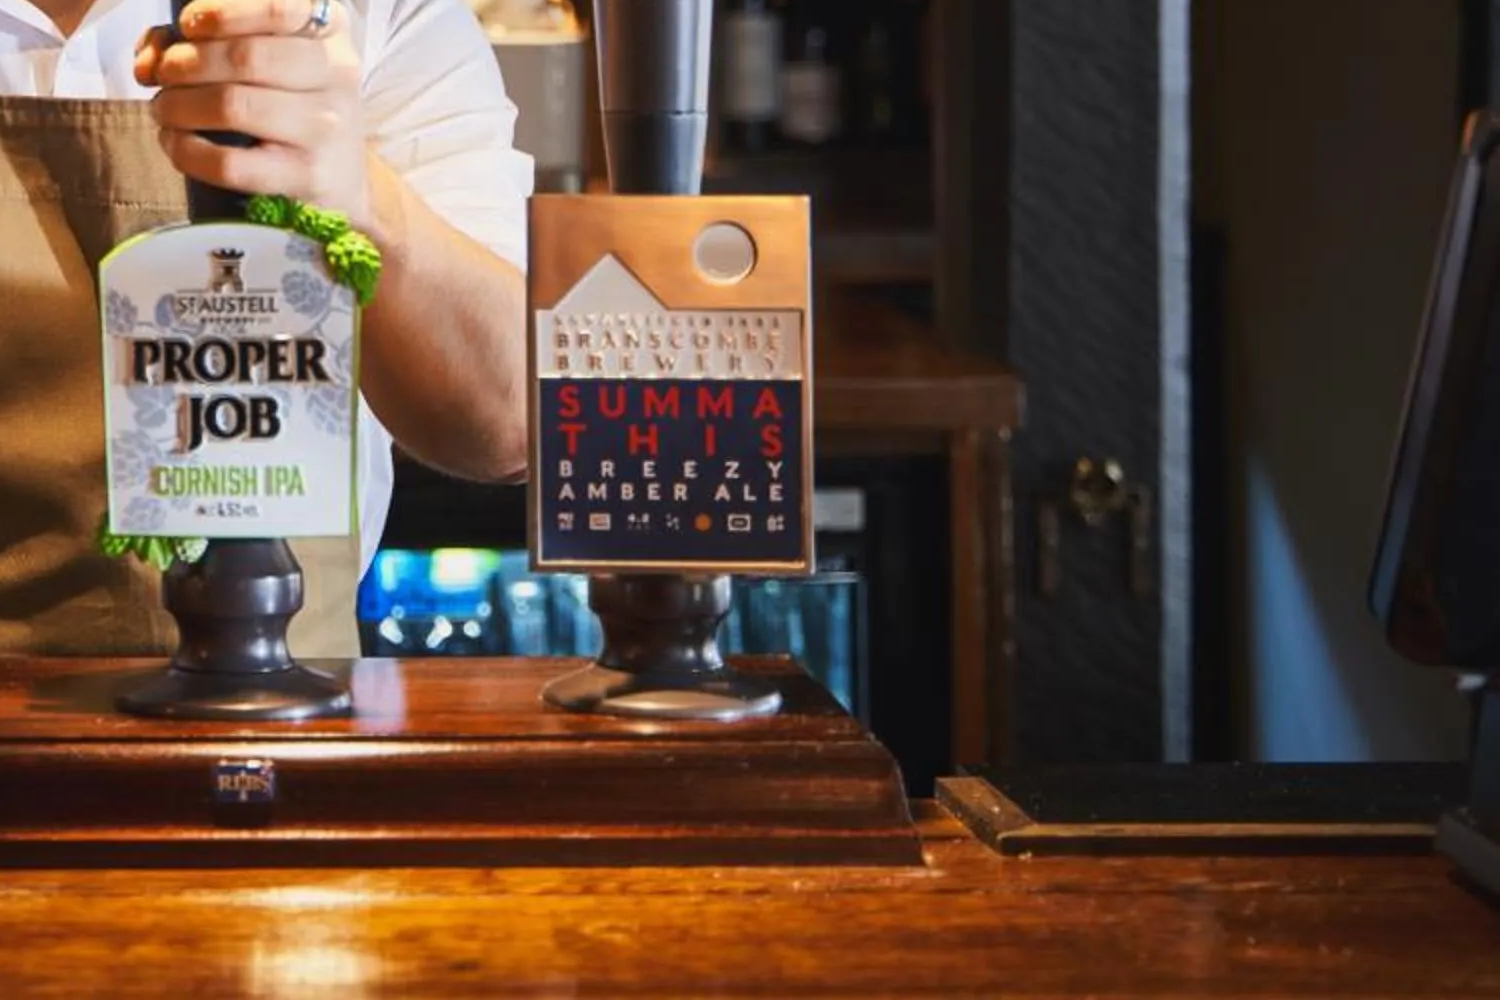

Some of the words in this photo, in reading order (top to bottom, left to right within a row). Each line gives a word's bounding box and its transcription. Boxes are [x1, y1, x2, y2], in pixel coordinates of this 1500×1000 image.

[198, 296, 279, 313] AUSTELL
[126, 337, 333, 385] PROPER
[558, 384, 783, 420] SUMMA
[177, 395, 282, 452] JOB
[558, 423, 783, 457] THIS
[153, 464, 258, 497] CORNISH
[263, 464, 306, 497] IPA
[559, 460, 783, 478] BREEZY
[558, 483, 689, 501] AMBER
[714, 483, 784, 501] ALE
